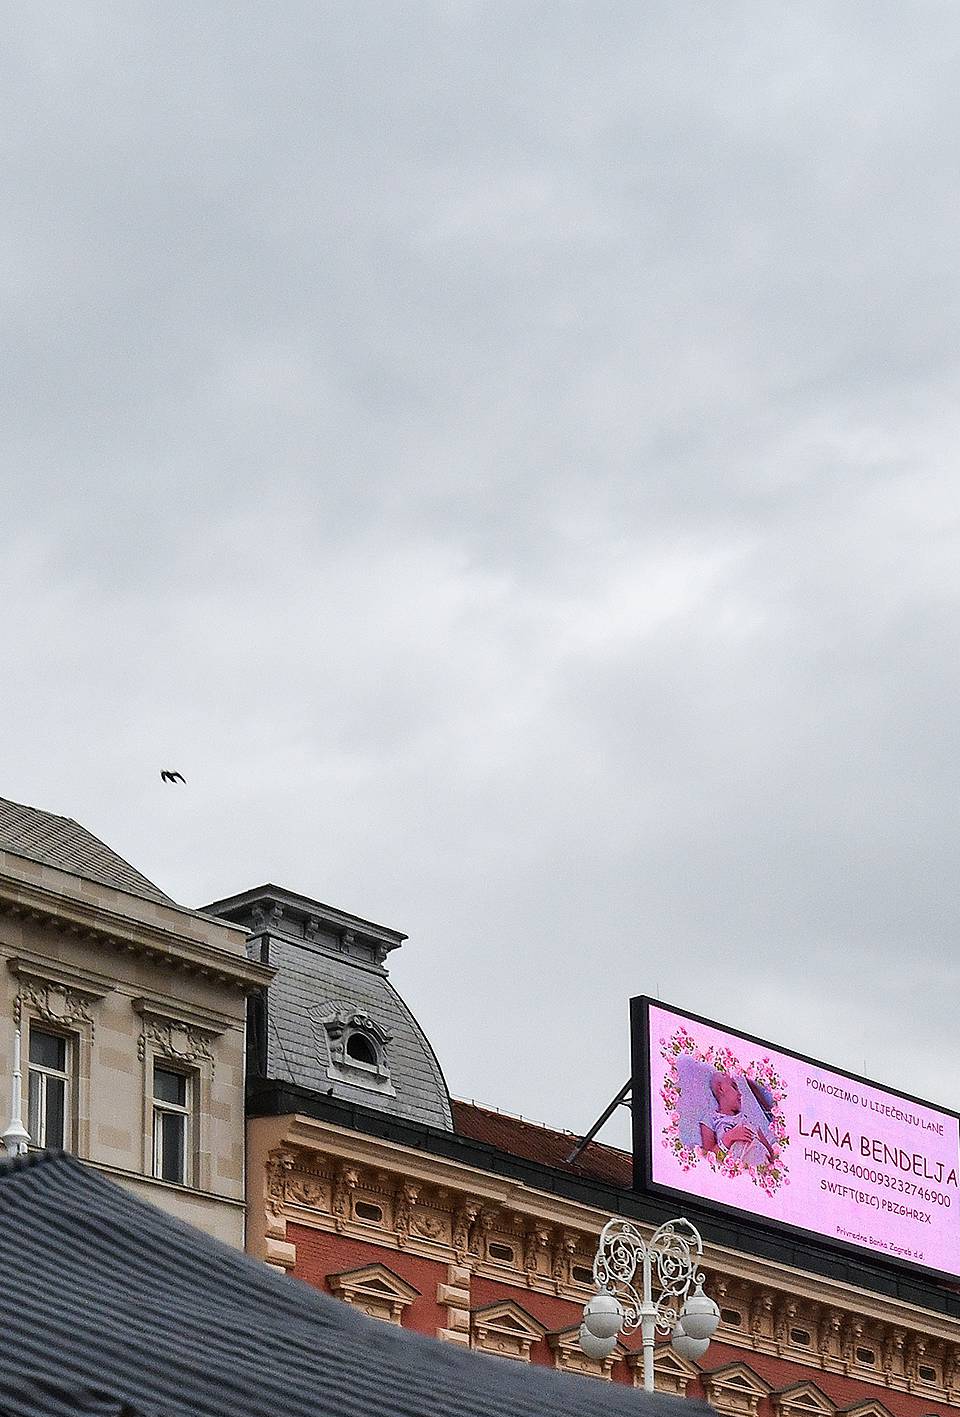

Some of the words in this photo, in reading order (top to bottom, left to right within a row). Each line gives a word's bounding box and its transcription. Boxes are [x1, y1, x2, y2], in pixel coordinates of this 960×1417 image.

[806, 1077, 859, 1104] POMOZIMO
[861, 1097, 868, 1108] U
[870, 1101, 919, 1126] LIJEČENJU
[921, 1119, 944, 1136] LANE
[798, 1114, 853, 1152] LANA
[860, 1136, 958, 1188] BENDELJA
[804, 1147, 952, 1208] HR7423400093232746900
[820, 1179, 880, 1209] SWIFT(BIC)
[881, 1199, 932, 1225] PBZGHR2X
[869, 1235, 888, 1249] Banka
[889, 1242, 912, 1257] Zagreb
